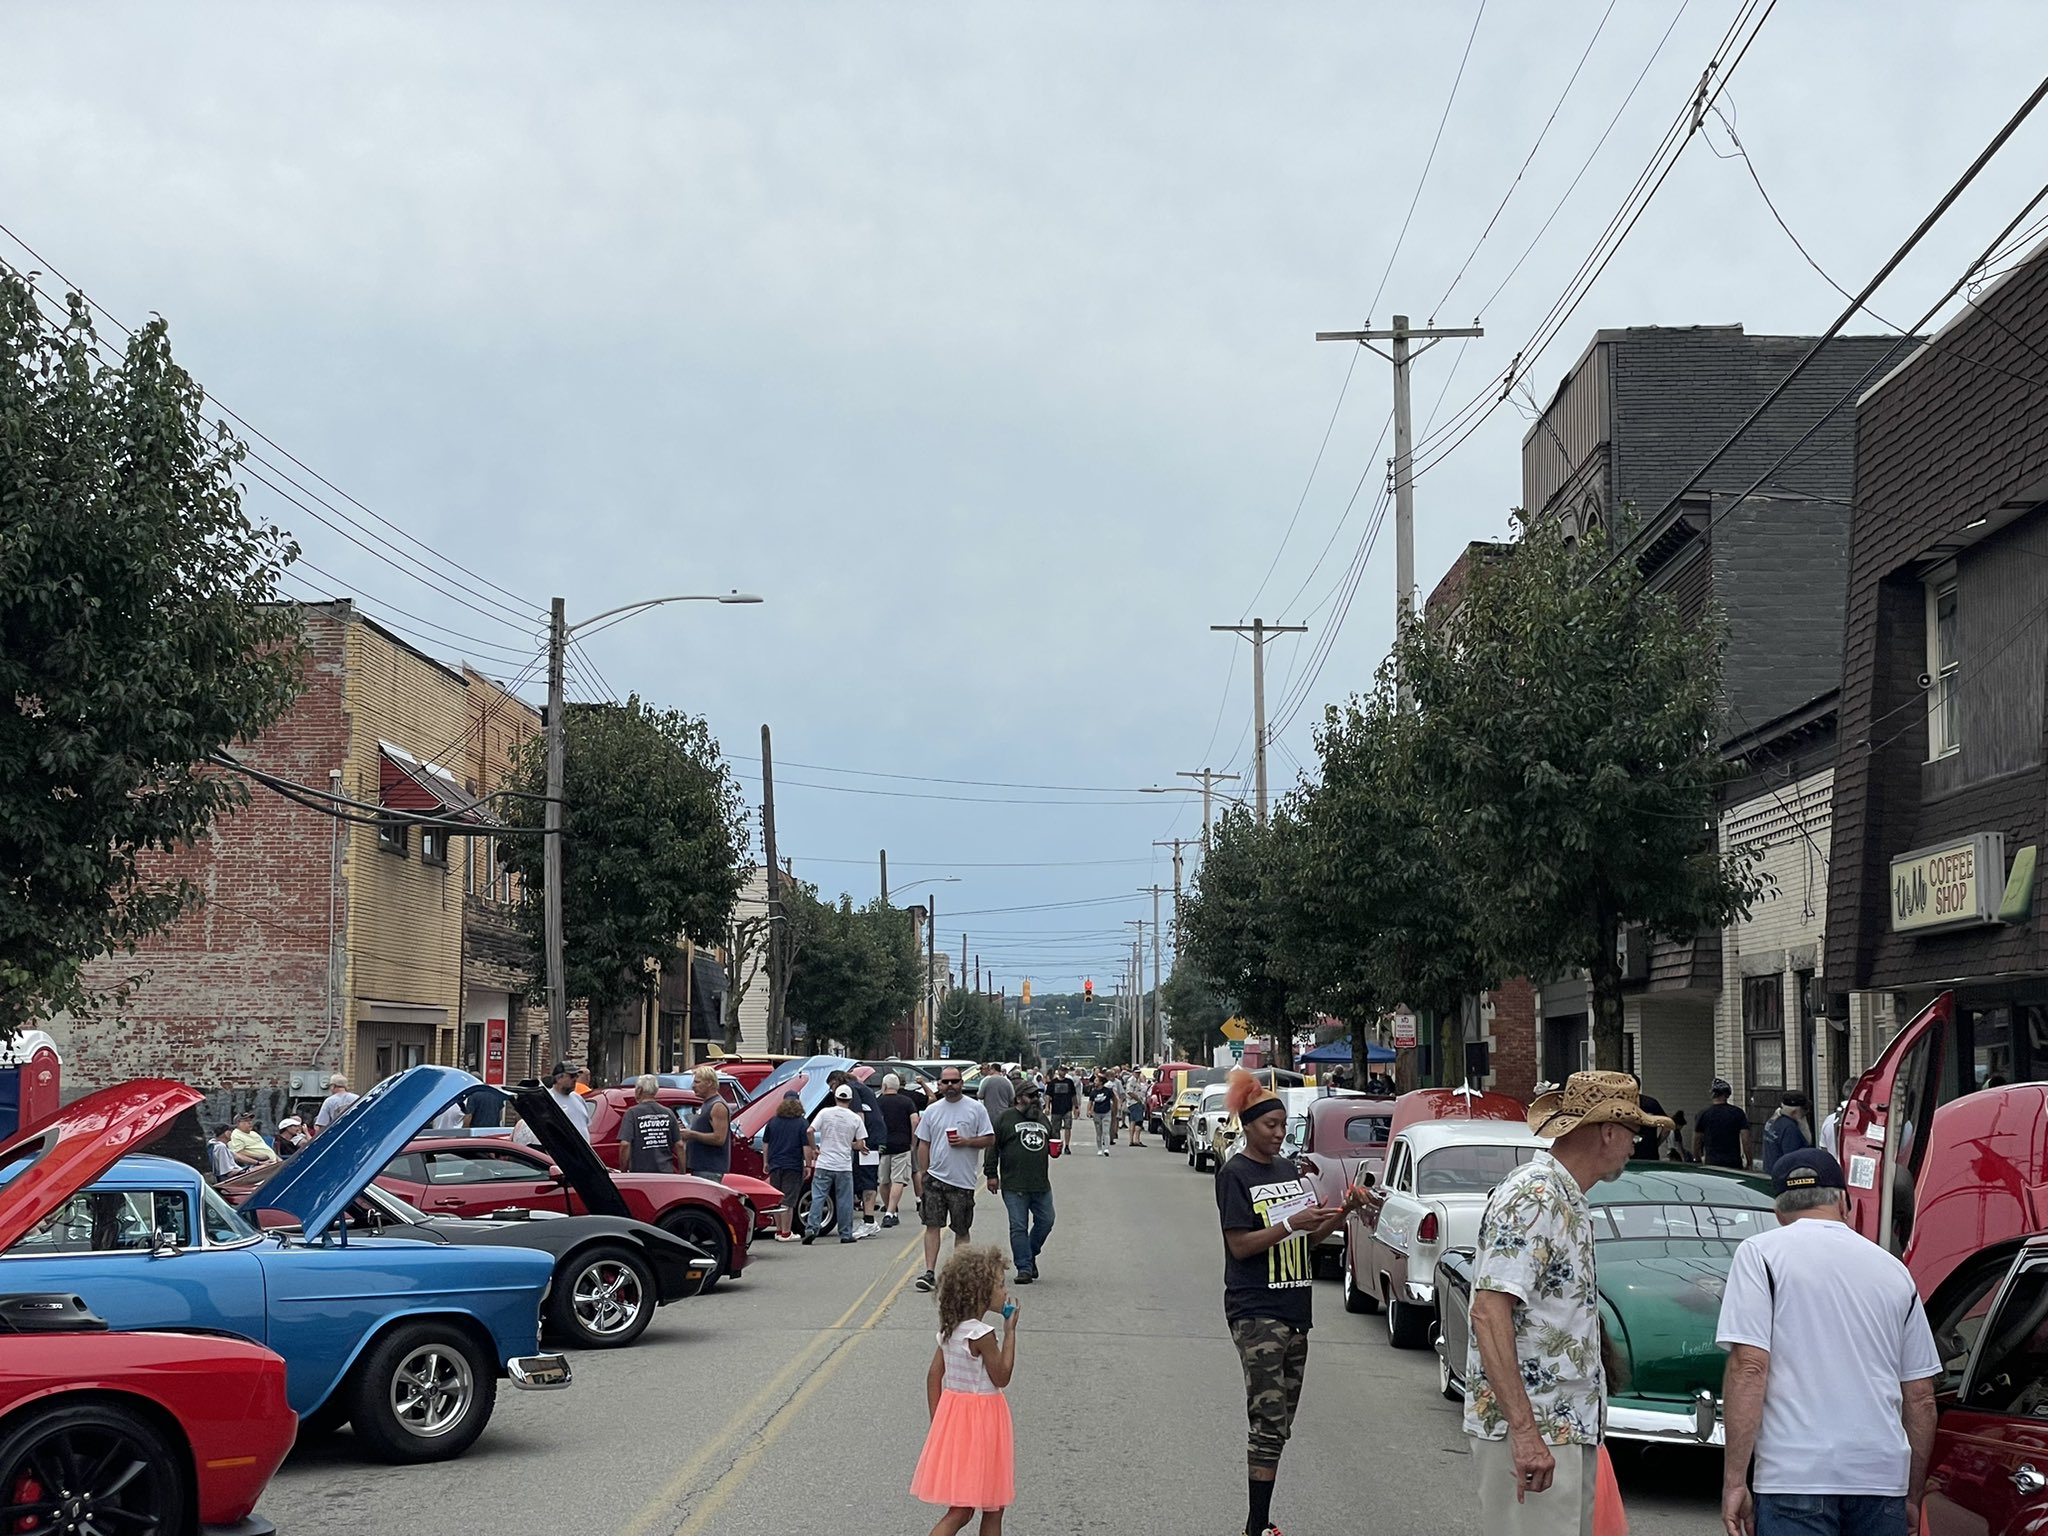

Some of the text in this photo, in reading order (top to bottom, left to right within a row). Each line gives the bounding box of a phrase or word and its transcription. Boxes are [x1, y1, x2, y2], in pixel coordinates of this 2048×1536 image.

[1929, 850, 1973, 887] COFFEE
[1936, 882, 1967, 915] SHOP
[1253, 1183, 1300, 1200] AIR
